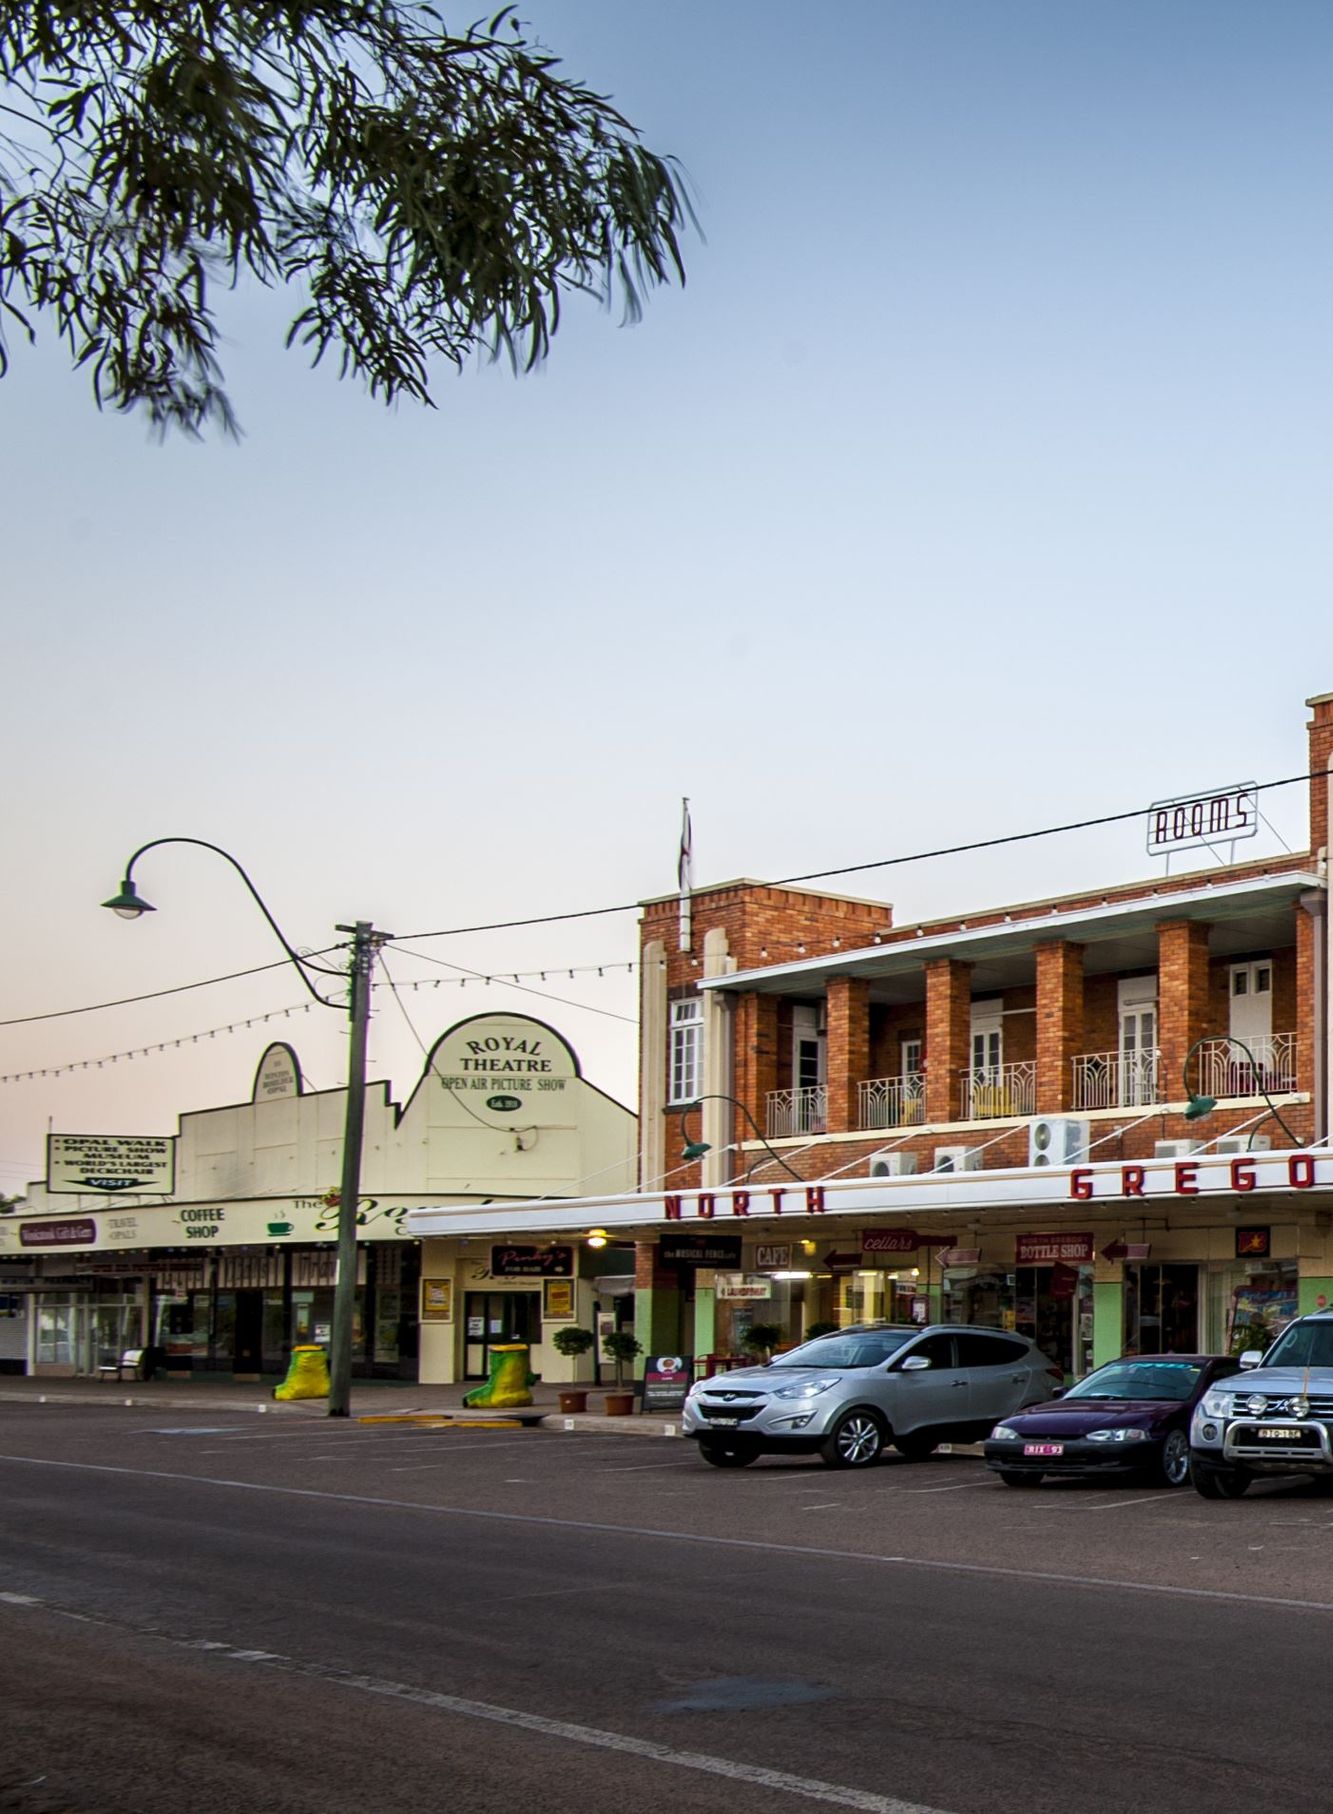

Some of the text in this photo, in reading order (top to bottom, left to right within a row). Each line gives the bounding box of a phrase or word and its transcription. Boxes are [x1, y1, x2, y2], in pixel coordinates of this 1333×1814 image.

[1155, 792, 1249, 844] ROOMS
[466, 1036, 543, 1056] ROYAL
[459, 1057, 553, 1072] THEATRE
[441, 1077, 567, 1091] OPEN AIR PICTURE SHOW
[62, 1138, 166, 1147] OPAL WALK
[64, 1145, 118, 1153] PICTURE
[64, 1159, 117, 1167] WORLD'S
[79, 1167, 155, 1175] DECKCHAIR
[90, 1178, 134, 1186] VISIT
[293, 1199, 323, 1210] The
[664, 1186, 826, 1220] NORTH
[180, 1208, 225, 1222] COFFEE
[186, 1225, 219, 1238] SHOP
[863, 1236, 912, 1250] cellars
[1020, 1243, 1089, 1259] BOTTLE SHOP
